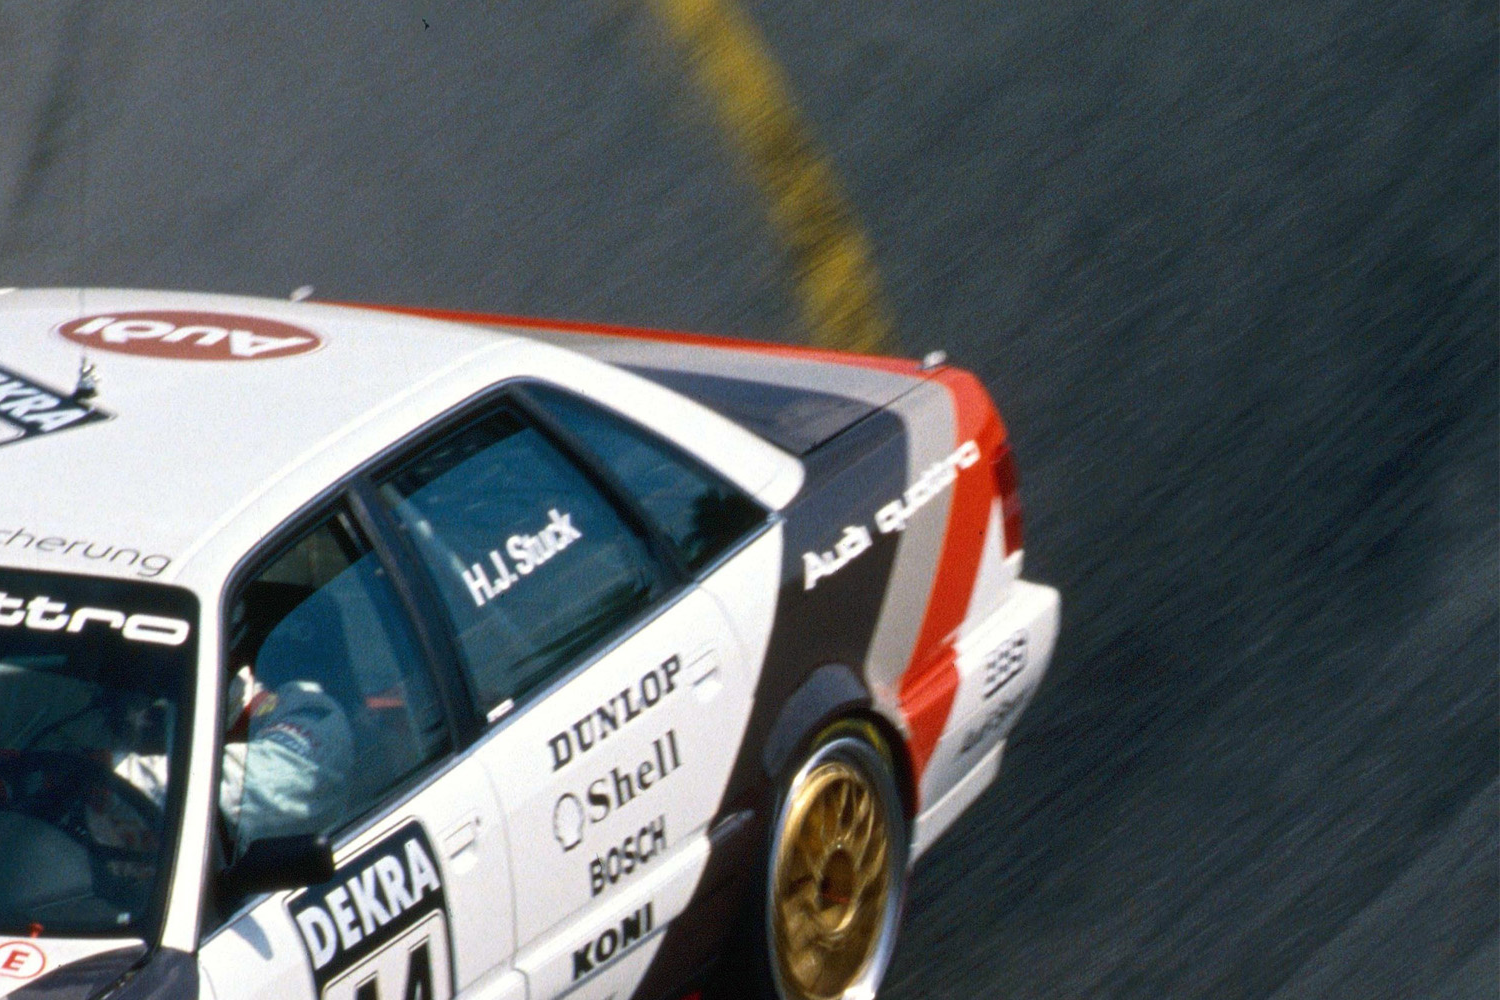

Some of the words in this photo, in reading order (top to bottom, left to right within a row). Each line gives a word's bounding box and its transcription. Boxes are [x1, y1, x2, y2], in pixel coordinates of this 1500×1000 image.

[75, 315, 312, 357] Audi
[802, 525, 874, 591] Audi
[548, 652, 682, 772] DUNLOP
[587, 730, 683, 828] Shell
[589, 814, 667, 899] BOSCH
[296, 838, 441, 971] DEKRA
[572, 901, 654, 982] KONI
[2, 949, 30, 971] E
